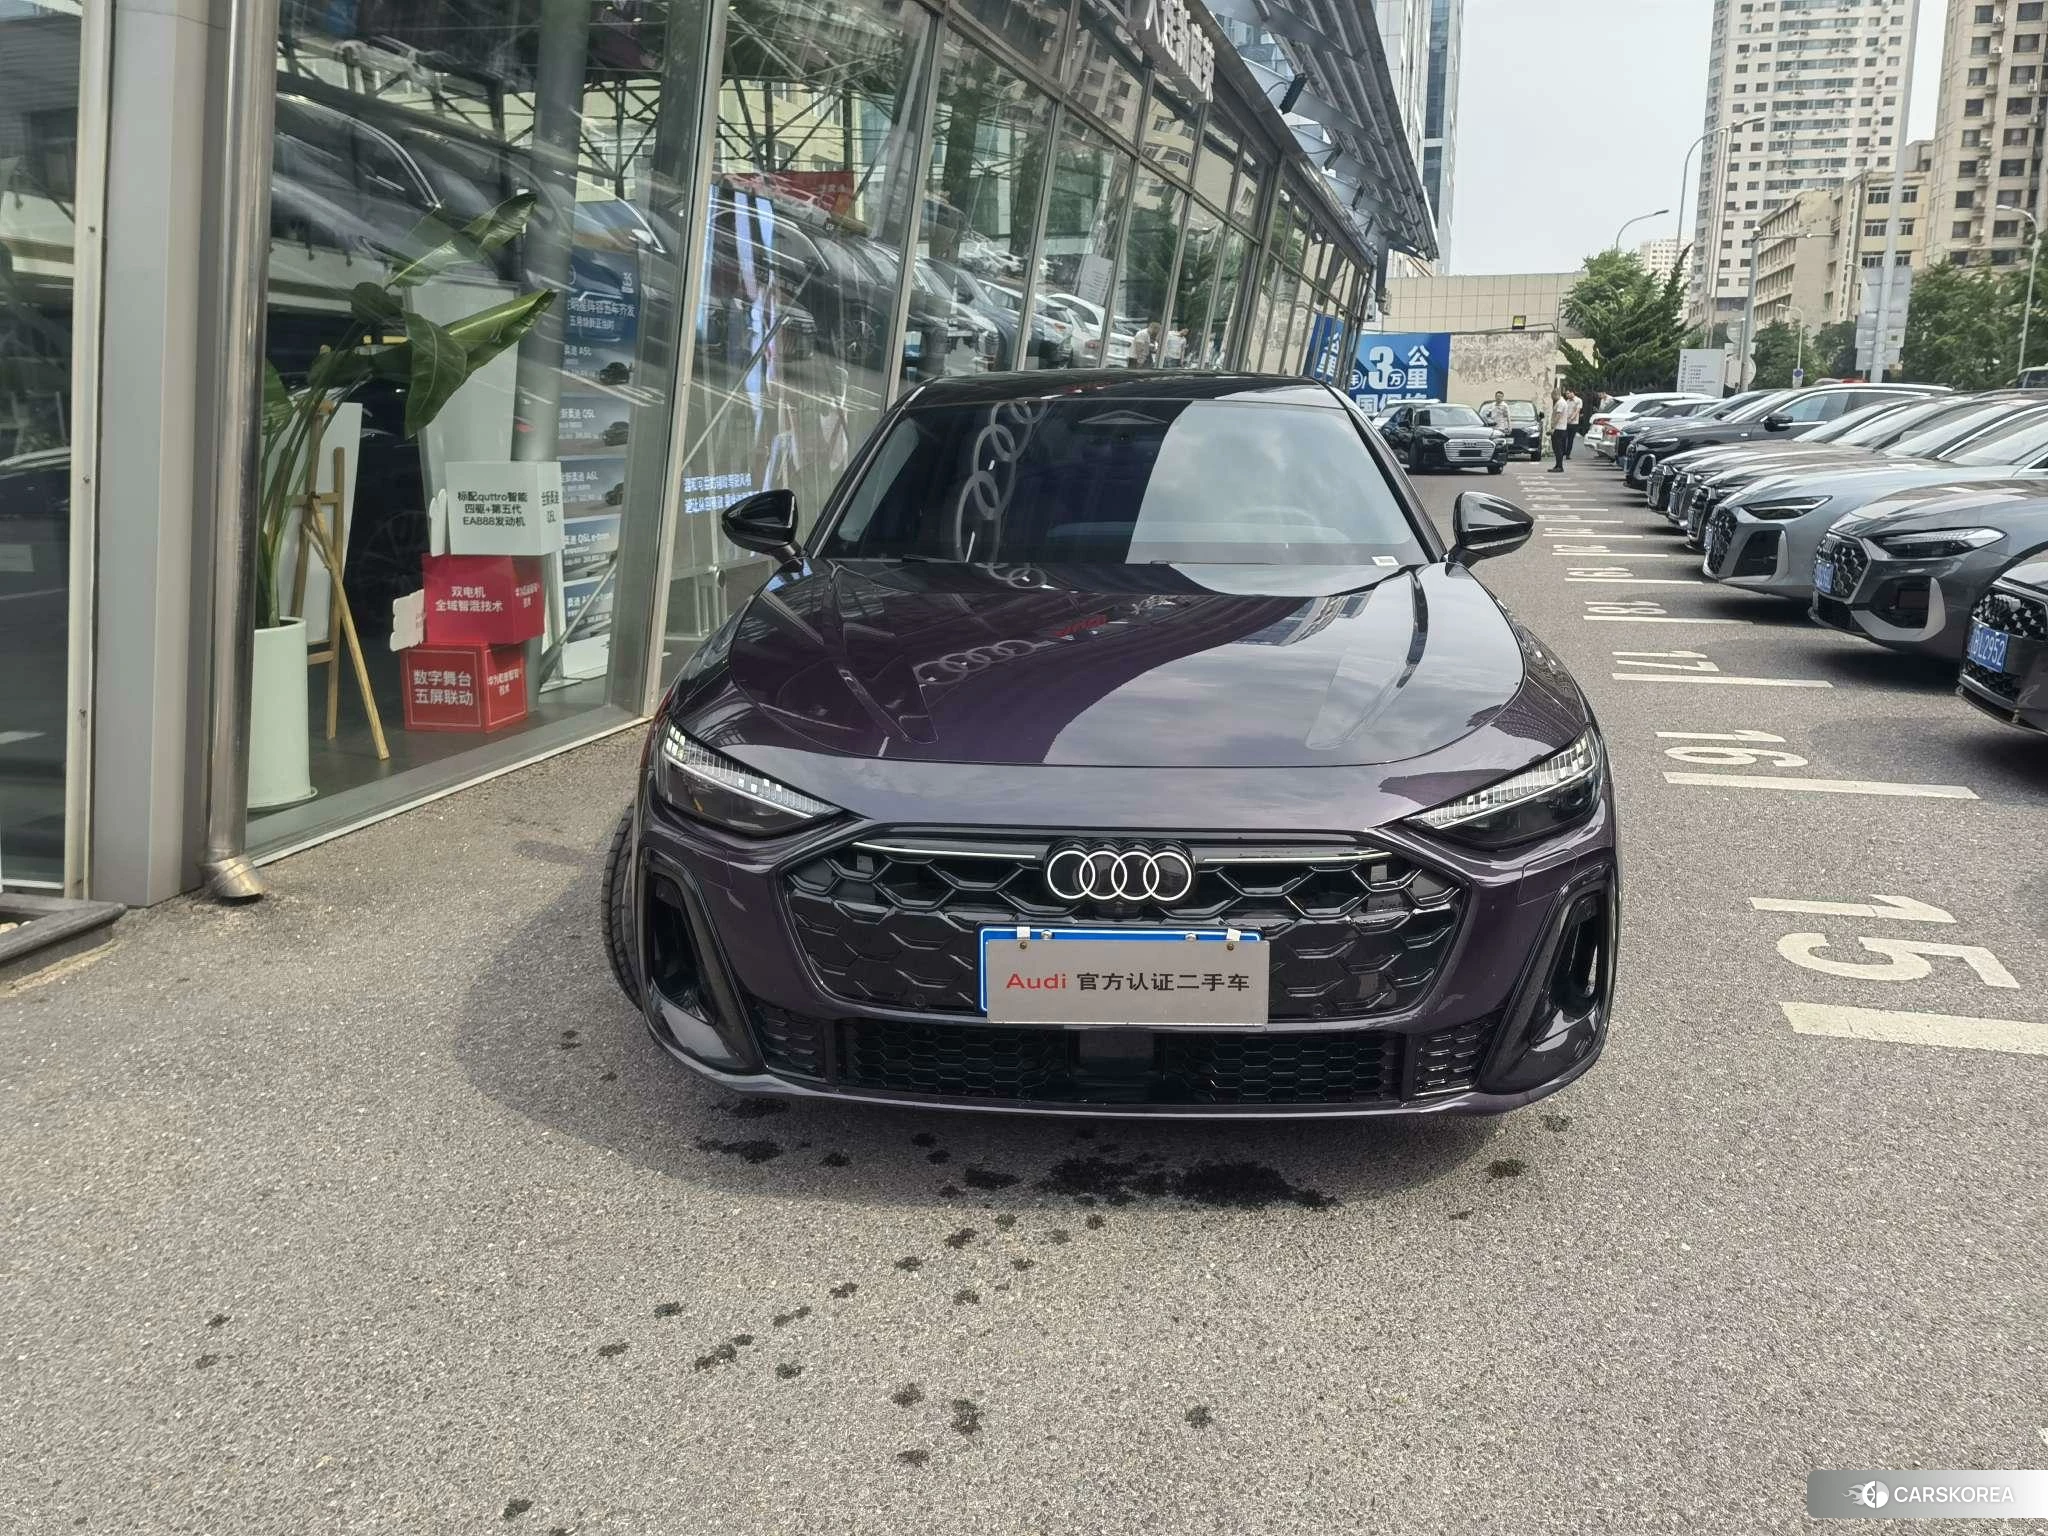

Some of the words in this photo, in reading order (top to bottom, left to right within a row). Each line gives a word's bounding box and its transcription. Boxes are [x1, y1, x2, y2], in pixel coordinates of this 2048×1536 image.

[464, 503, 522, 515] 四驱+第五代
[463, 516, 526, 527] EA888发动机
[1567, 567, 1634, 577] 19
[451, 586, 486, 598] 双电机
[435, 600, 504, 612] 全域智混技术
[1585, 601, 1667, 614] 18
[1612, 650, 1720, 672] 17
[413, 670, 472, 686] 数字舞台
[415, 688, 474, 706] 五屏联动
[1655, 729, 1808, 767] 16
[1749, 894, 2020, 989] 15
[1006, 972, 1067, 990] Audi
[1076, 972, 1250, 992] 官方认证二手车
